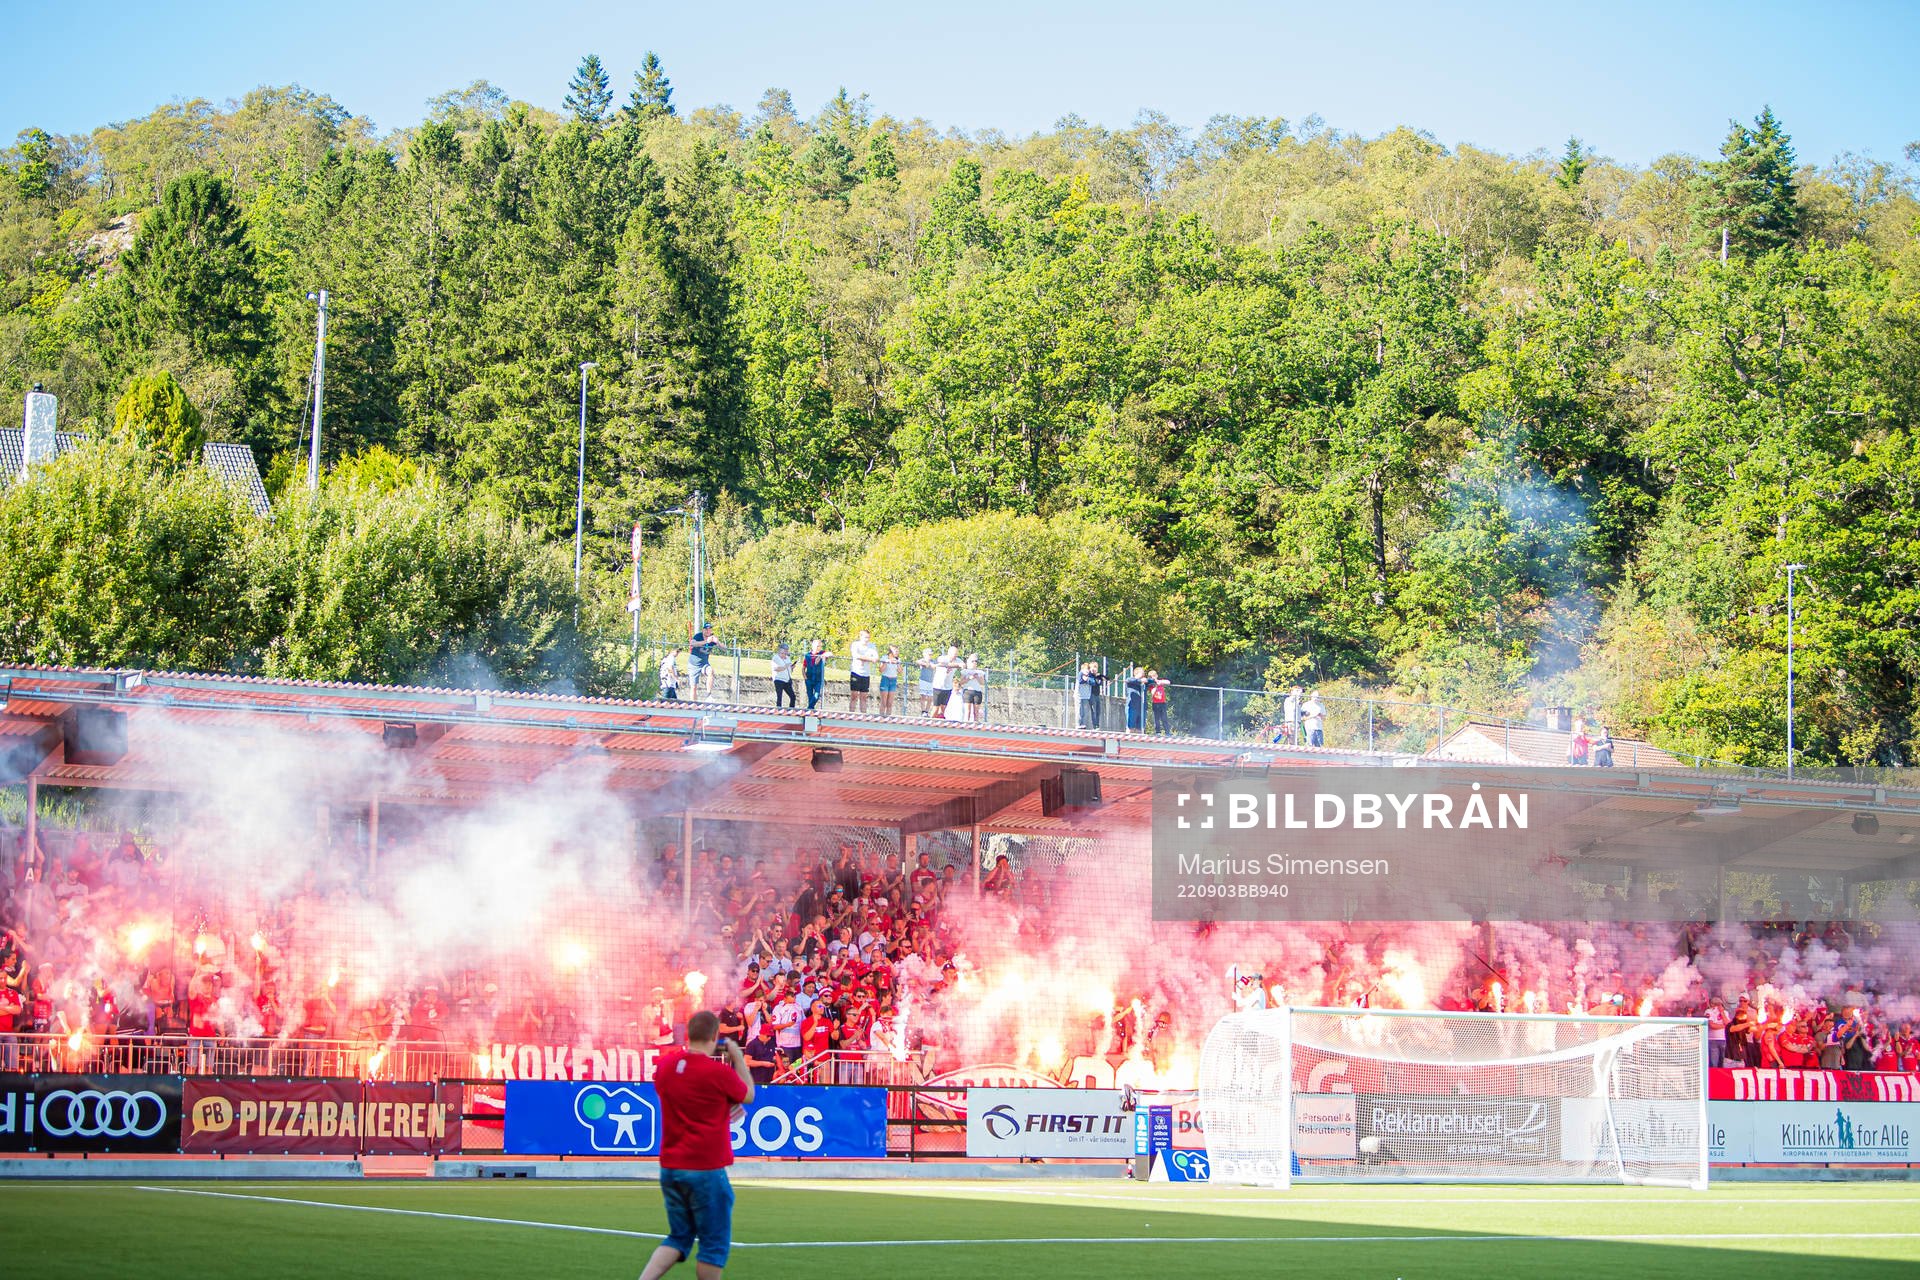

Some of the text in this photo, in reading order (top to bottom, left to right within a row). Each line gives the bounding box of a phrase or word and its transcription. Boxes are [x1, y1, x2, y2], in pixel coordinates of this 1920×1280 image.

[203, 1100, 446, 1138] PB PIZZABAKEREN
[1025, 1114, 1127, 1133] FIRST IT
[1373, 1108, 1502, 1134] Reklamehuset
[1782, 1124, 1909, 1146] Klinikk for Alle
